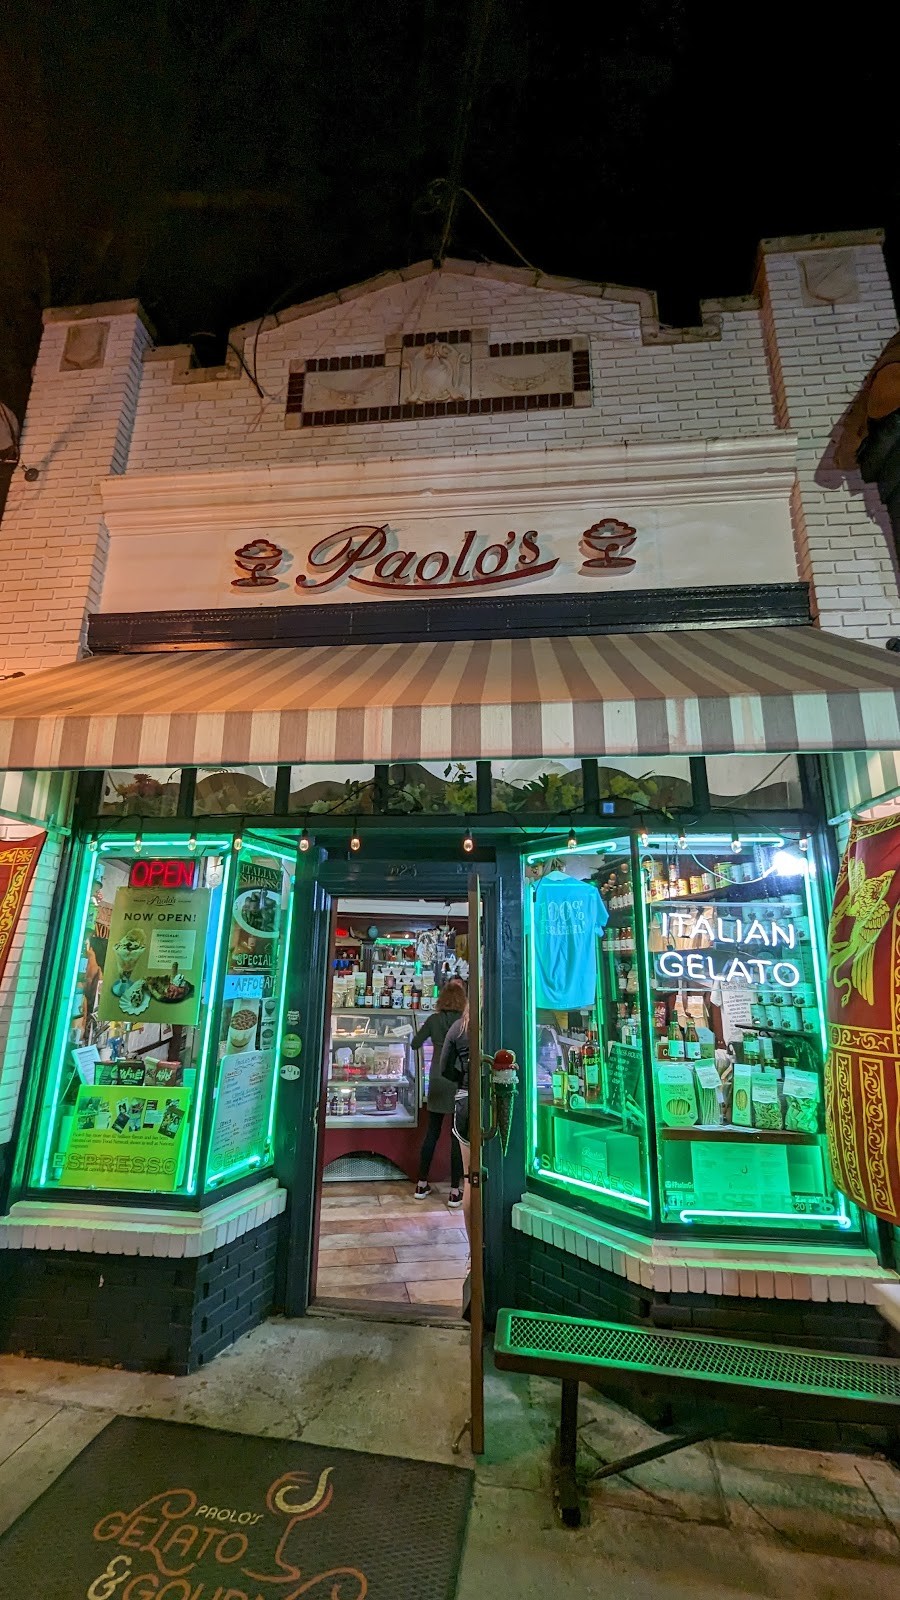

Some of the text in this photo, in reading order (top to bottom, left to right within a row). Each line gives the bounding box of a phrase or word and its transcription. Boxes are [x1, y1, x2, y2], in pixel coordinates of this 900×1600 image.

[296, 524, 559, 590] Paolo's
[130, 861, 195, 888] OPEN
[124, 912, 197, 922] NOW OPEN!
[660, 911, 796, 950] ITALIAN
[658, 951, 801, 988] GELATO
[52, 1152, 177, 1175] ESPRESSO
[541, 1154, 635, 1196] SUNDAES
[93, 1492, 248, 1573] GELATO
[195, 1504, 264, 1525] PAOLO'S
[87, 1555, 132, 1600] &
